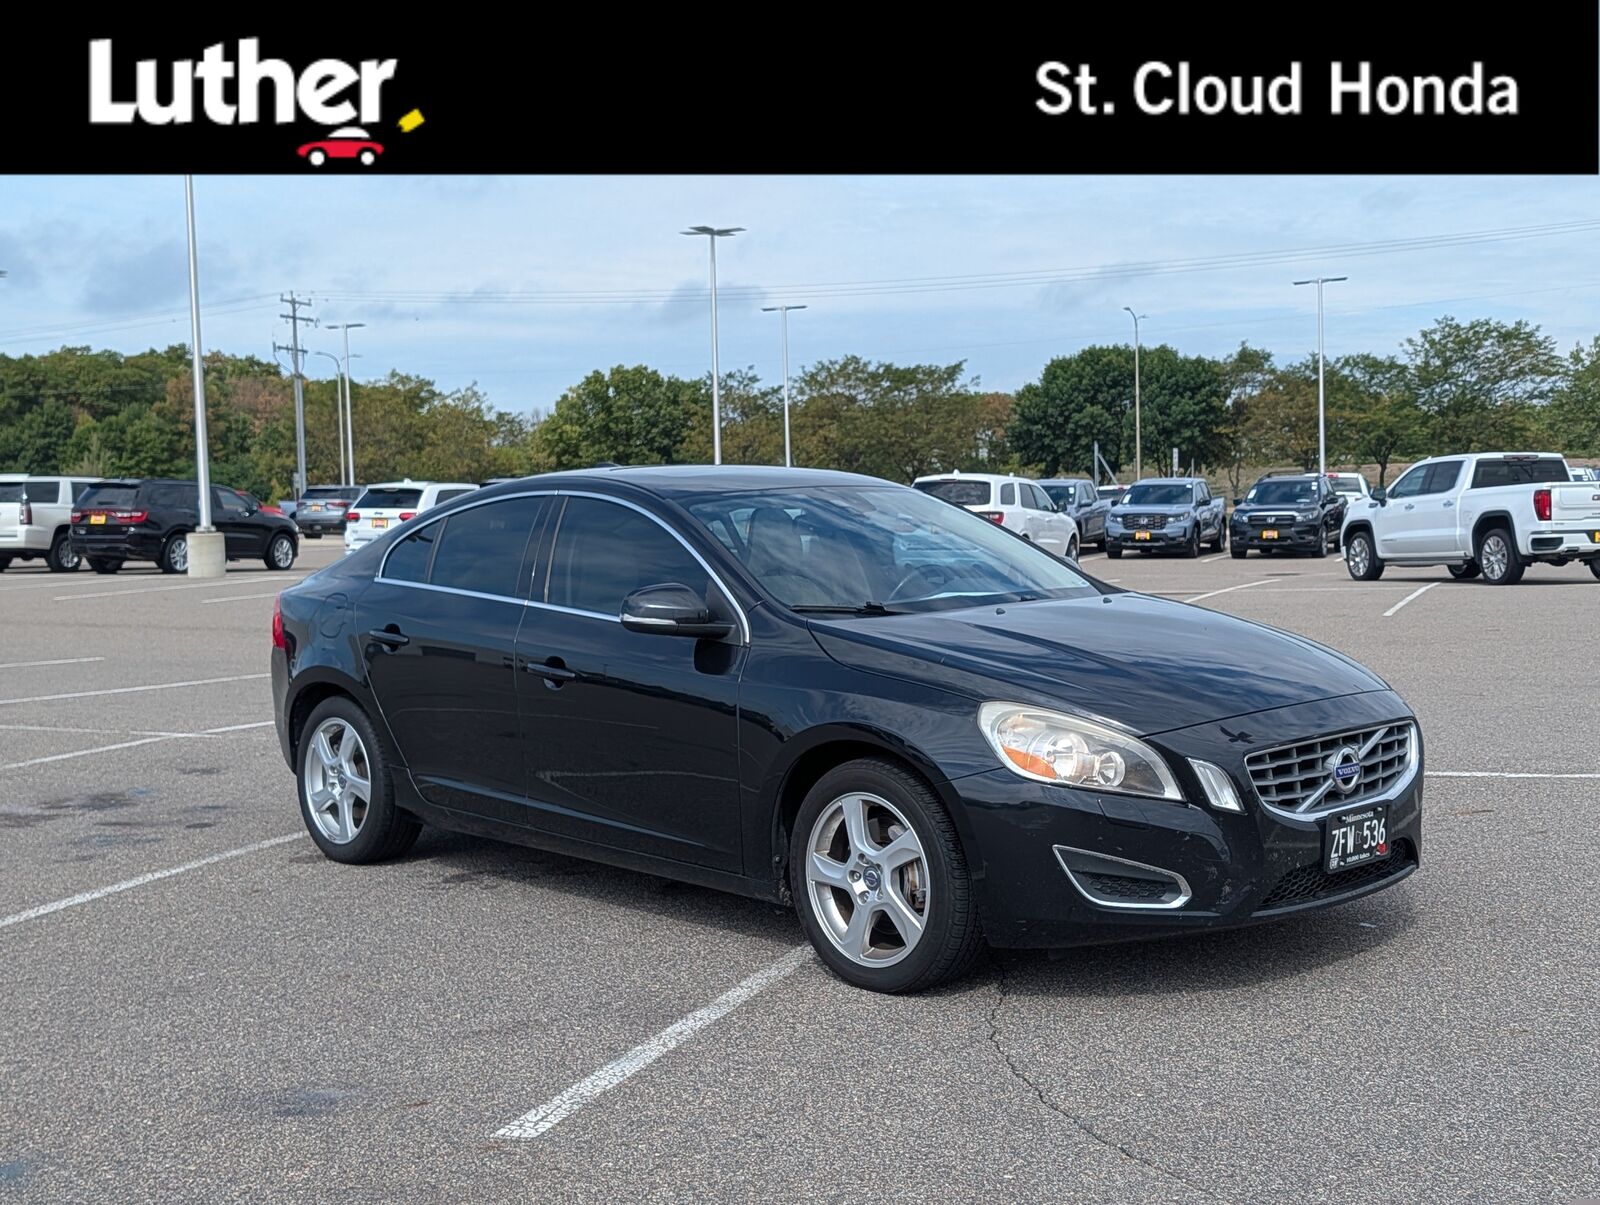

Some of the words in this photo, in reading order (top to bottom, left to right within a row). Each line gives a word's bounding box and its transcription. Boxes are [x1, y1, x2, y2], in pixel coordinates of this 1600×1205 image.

[1338, 765, 1360, 775] VOLVO
[1345, 811, 1374, 823] Minnesota
[1330, 825, 1355, 858] ZFW
[1363, 817, 1386, 849] 536
